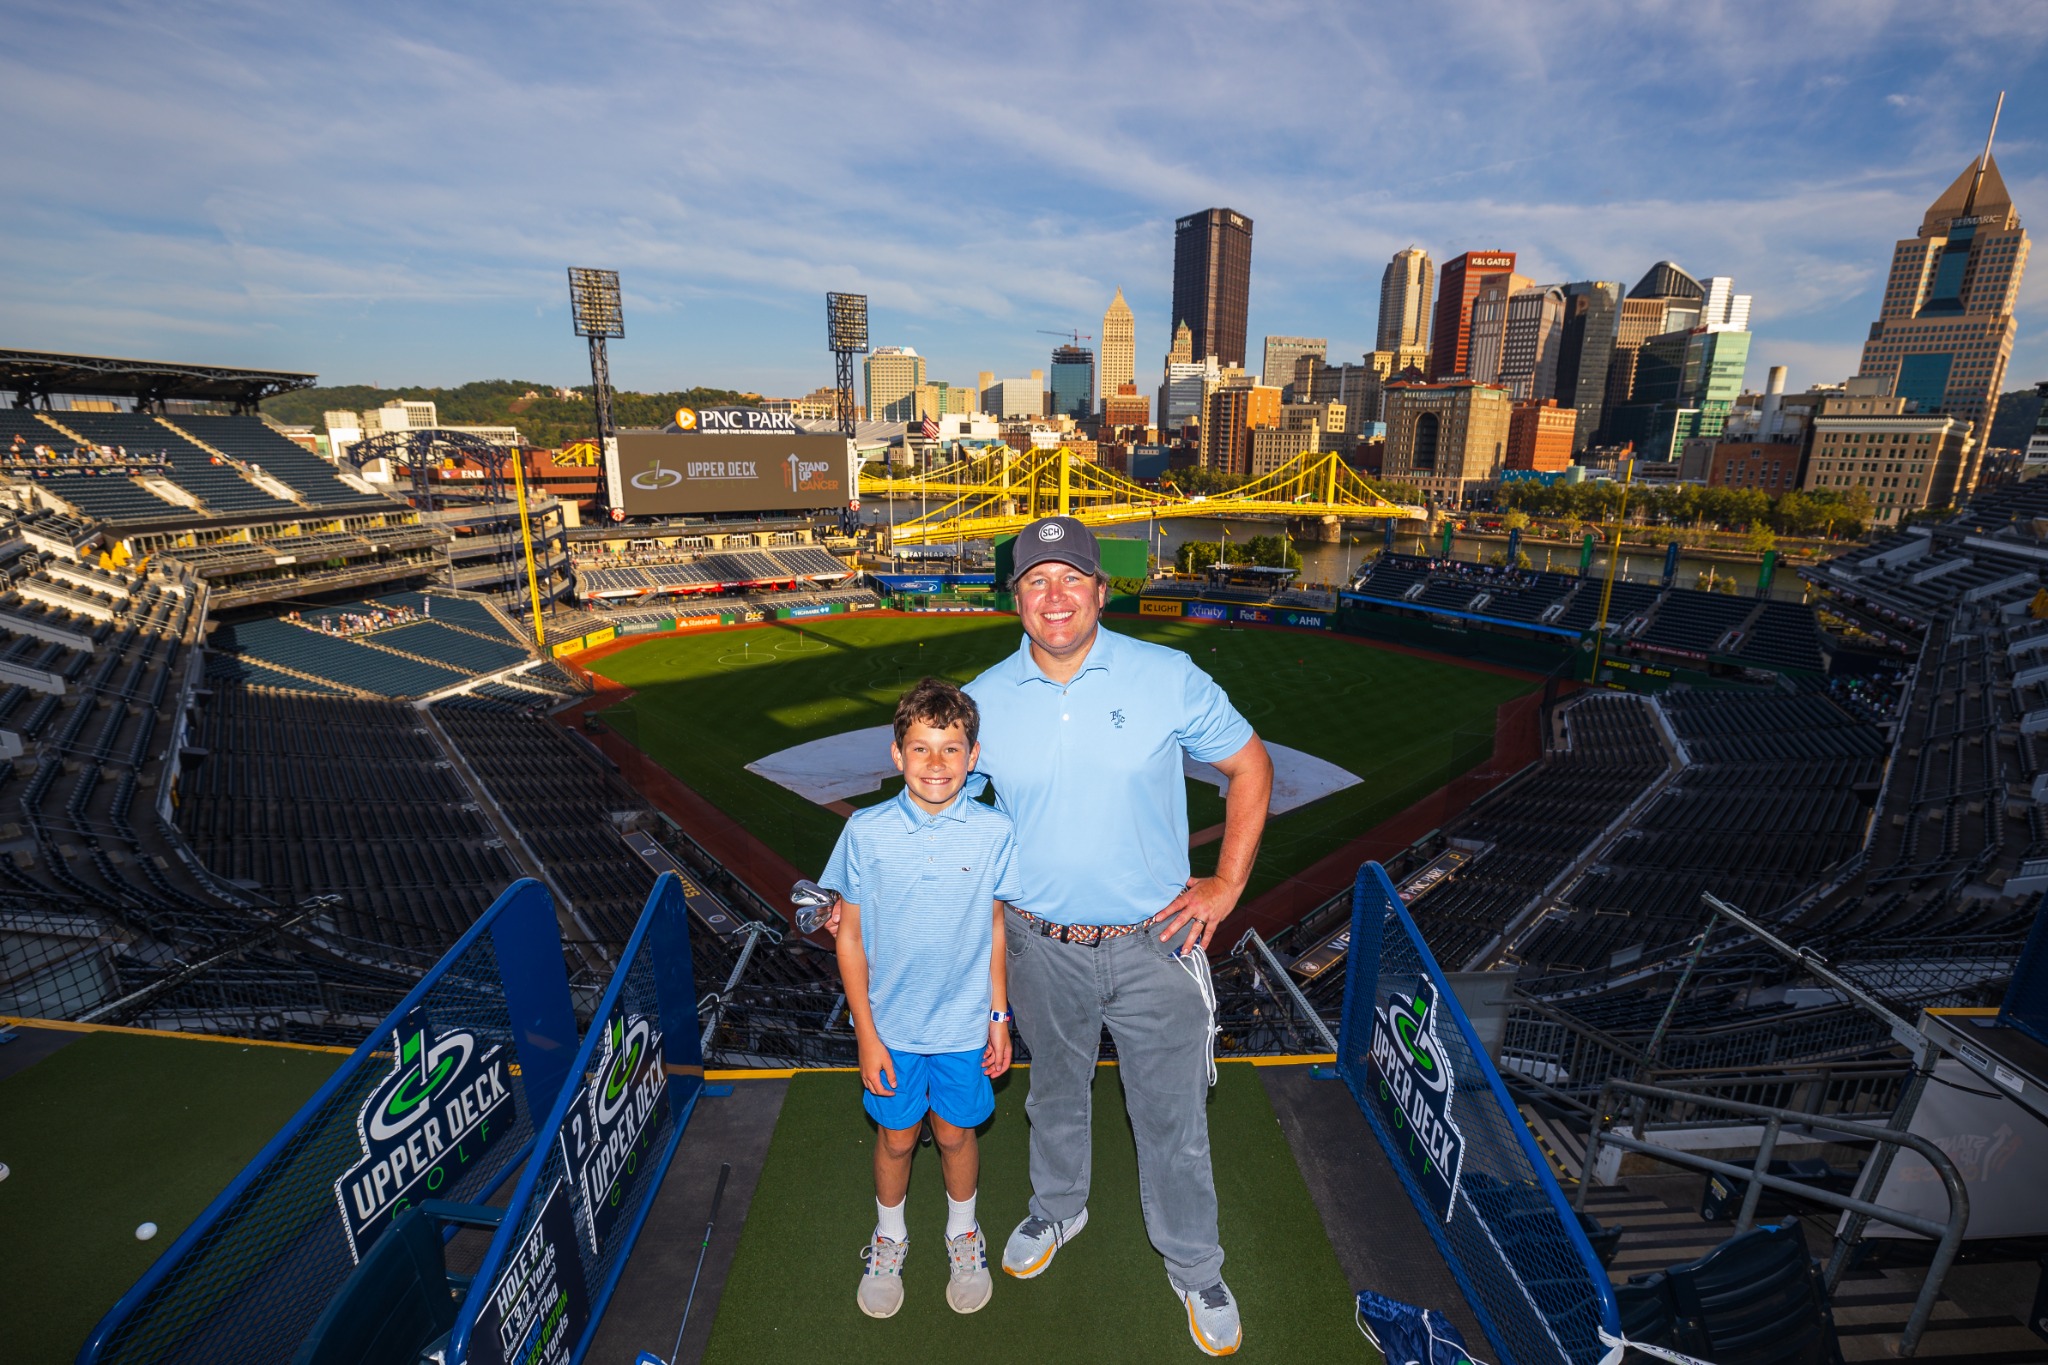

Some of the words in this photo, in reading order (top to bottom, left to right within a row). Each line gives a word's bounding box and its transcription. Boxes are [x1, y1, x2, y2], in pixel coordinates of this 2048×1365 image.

[1471, 257, 1486, 266] K&L
[1486, 258, 1511, 267] GATES
[699, 410, 743, 428] PNC
[746, 412, 796, 429] PARK
[687, 461, 725, 477] UPPER
[728, 461, 757, 477] DECK
[798, 461, 829, 473] STAND
[799, 472, 811, 481] UP
[812, 472, 824, 481] TO
[799, 480, 839, 491] CANCER
[1042, 527, 1060, 537] SCH
[1154, 604, 1178, 613] LIGHT
[1191, 602, 1224, 618] xfinity
[1240, 609, 1268, 622] FedEx
[1299, 616, 1321, 627] AHN
[1404, 880, 1430, 895] PNC
[1423, 866, 1448, 884] PARK
[1373, 1021, 1412, 1111] UPPER
[1411, 1088, 1455, 1177] DECK
[572, 1113, 586, 1159] 2
[591, 1102, 637, 1203] UPPER
[635, 1047, 665, 1126] DECK
[1379, 1080, 1432, 1175] GOLF
[352, 1116, 444, 1220] UPPER
[445, 1060, 505, 1140] DECK
[611, 1106, 658, 1207] GOLF
[496, 1252, 531, 1318] HOLE
[530, 1222, 545, 1263] #7
[529, 1242, 556, 1292] Yards
[539, 1282, 559, 1322] Flag
[542, 1288, 568, 1345] OPTION
[543, 1313, 569, 1363] Yards
